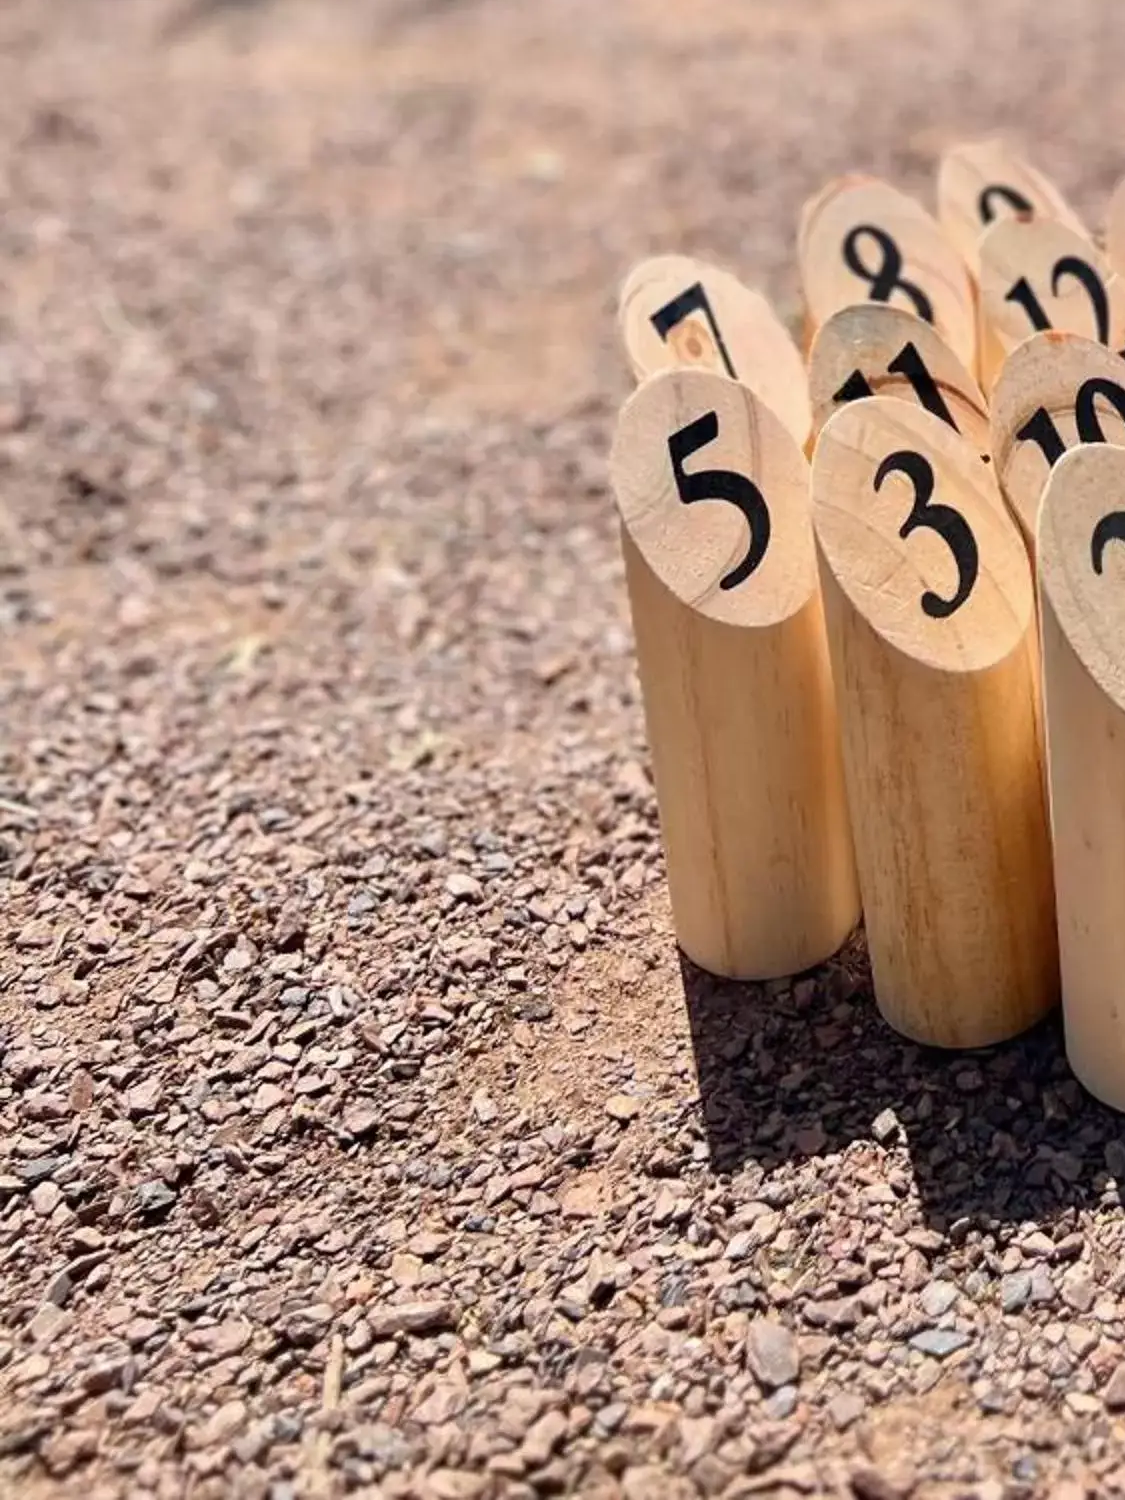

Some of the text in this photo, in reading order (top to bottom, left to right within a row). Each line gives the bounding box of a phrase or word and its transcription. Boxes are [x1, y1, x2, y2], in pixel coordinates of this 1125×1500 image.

[843, 224, 935, 324] 8
[650, 282, 738, 380] 7
[832, 341, 962, 435] 1
[667, 410, 772, 592] 5
[873, 449, 980, 620] 3
